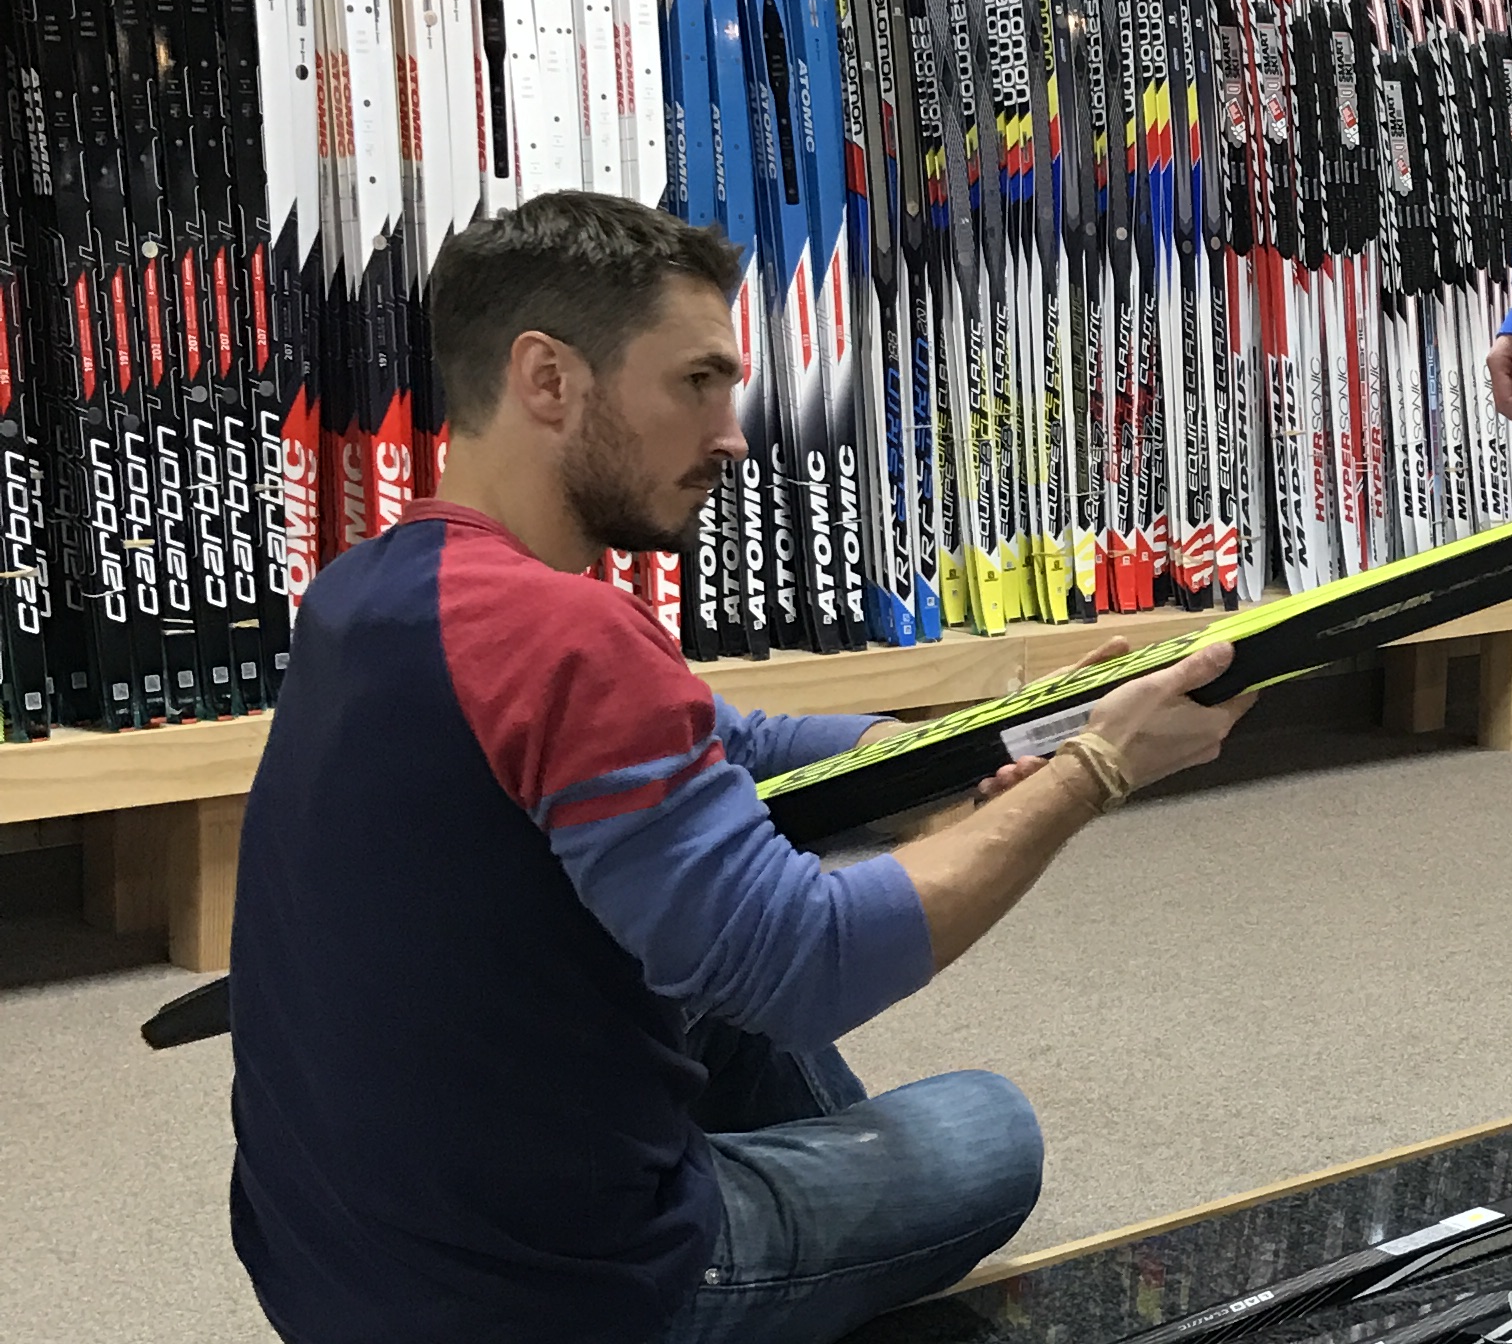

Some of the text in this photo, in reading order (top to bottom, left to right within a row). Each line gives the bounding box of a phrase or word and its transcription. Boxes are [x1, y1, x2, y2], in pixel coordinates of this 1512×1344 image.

[710, 102, 726, 203] ATOMIC
[797, 58, 816, 155] ATOMIC
[90, 438, 127, 624] carbon
[157, 425, 191, 613] carbon
[193, 418, 227, 608] carbon
[224, 416, 256, 605] carbon
[1215, 389, 1229, 491] EQUIPE
[1235, 358, 1254, 567] MADSHUS
[6, 450, 40, 635] carbon
[741, 458, 766, 630] ATOMIC
[806, 450, 836, 624] ATOMIC
[838, 444, 865, 623] ATOMIC
